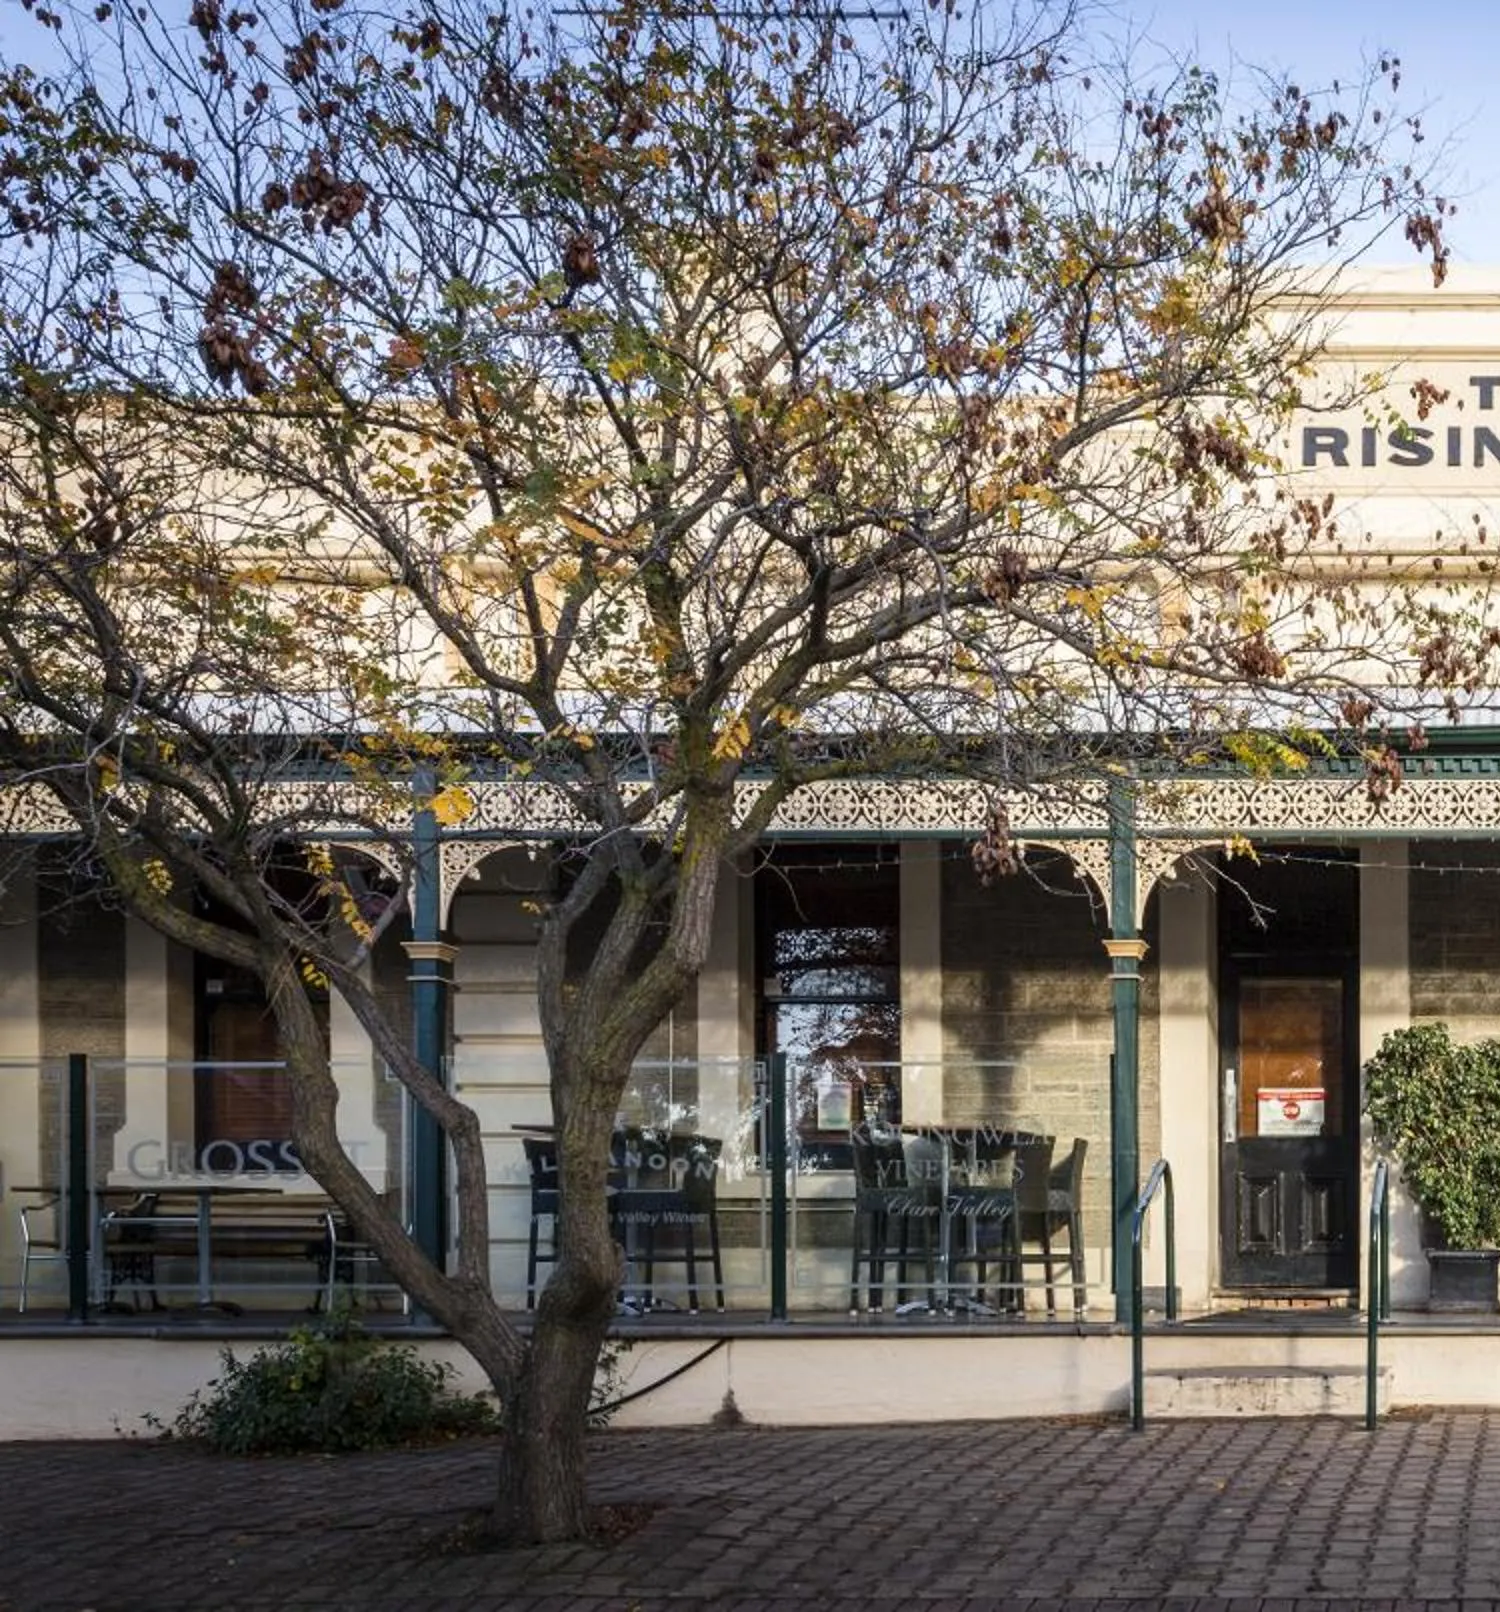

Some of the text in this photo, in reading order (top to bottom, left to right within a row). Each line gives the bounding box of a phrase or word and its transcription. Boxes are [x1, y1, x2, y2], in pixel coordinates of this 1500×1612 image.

[126, 1139, 370, 1181] GROSST
[877, 1159, 1026, 1184] VINEARDS
[947, 1194, 1013, 1223] Valley
